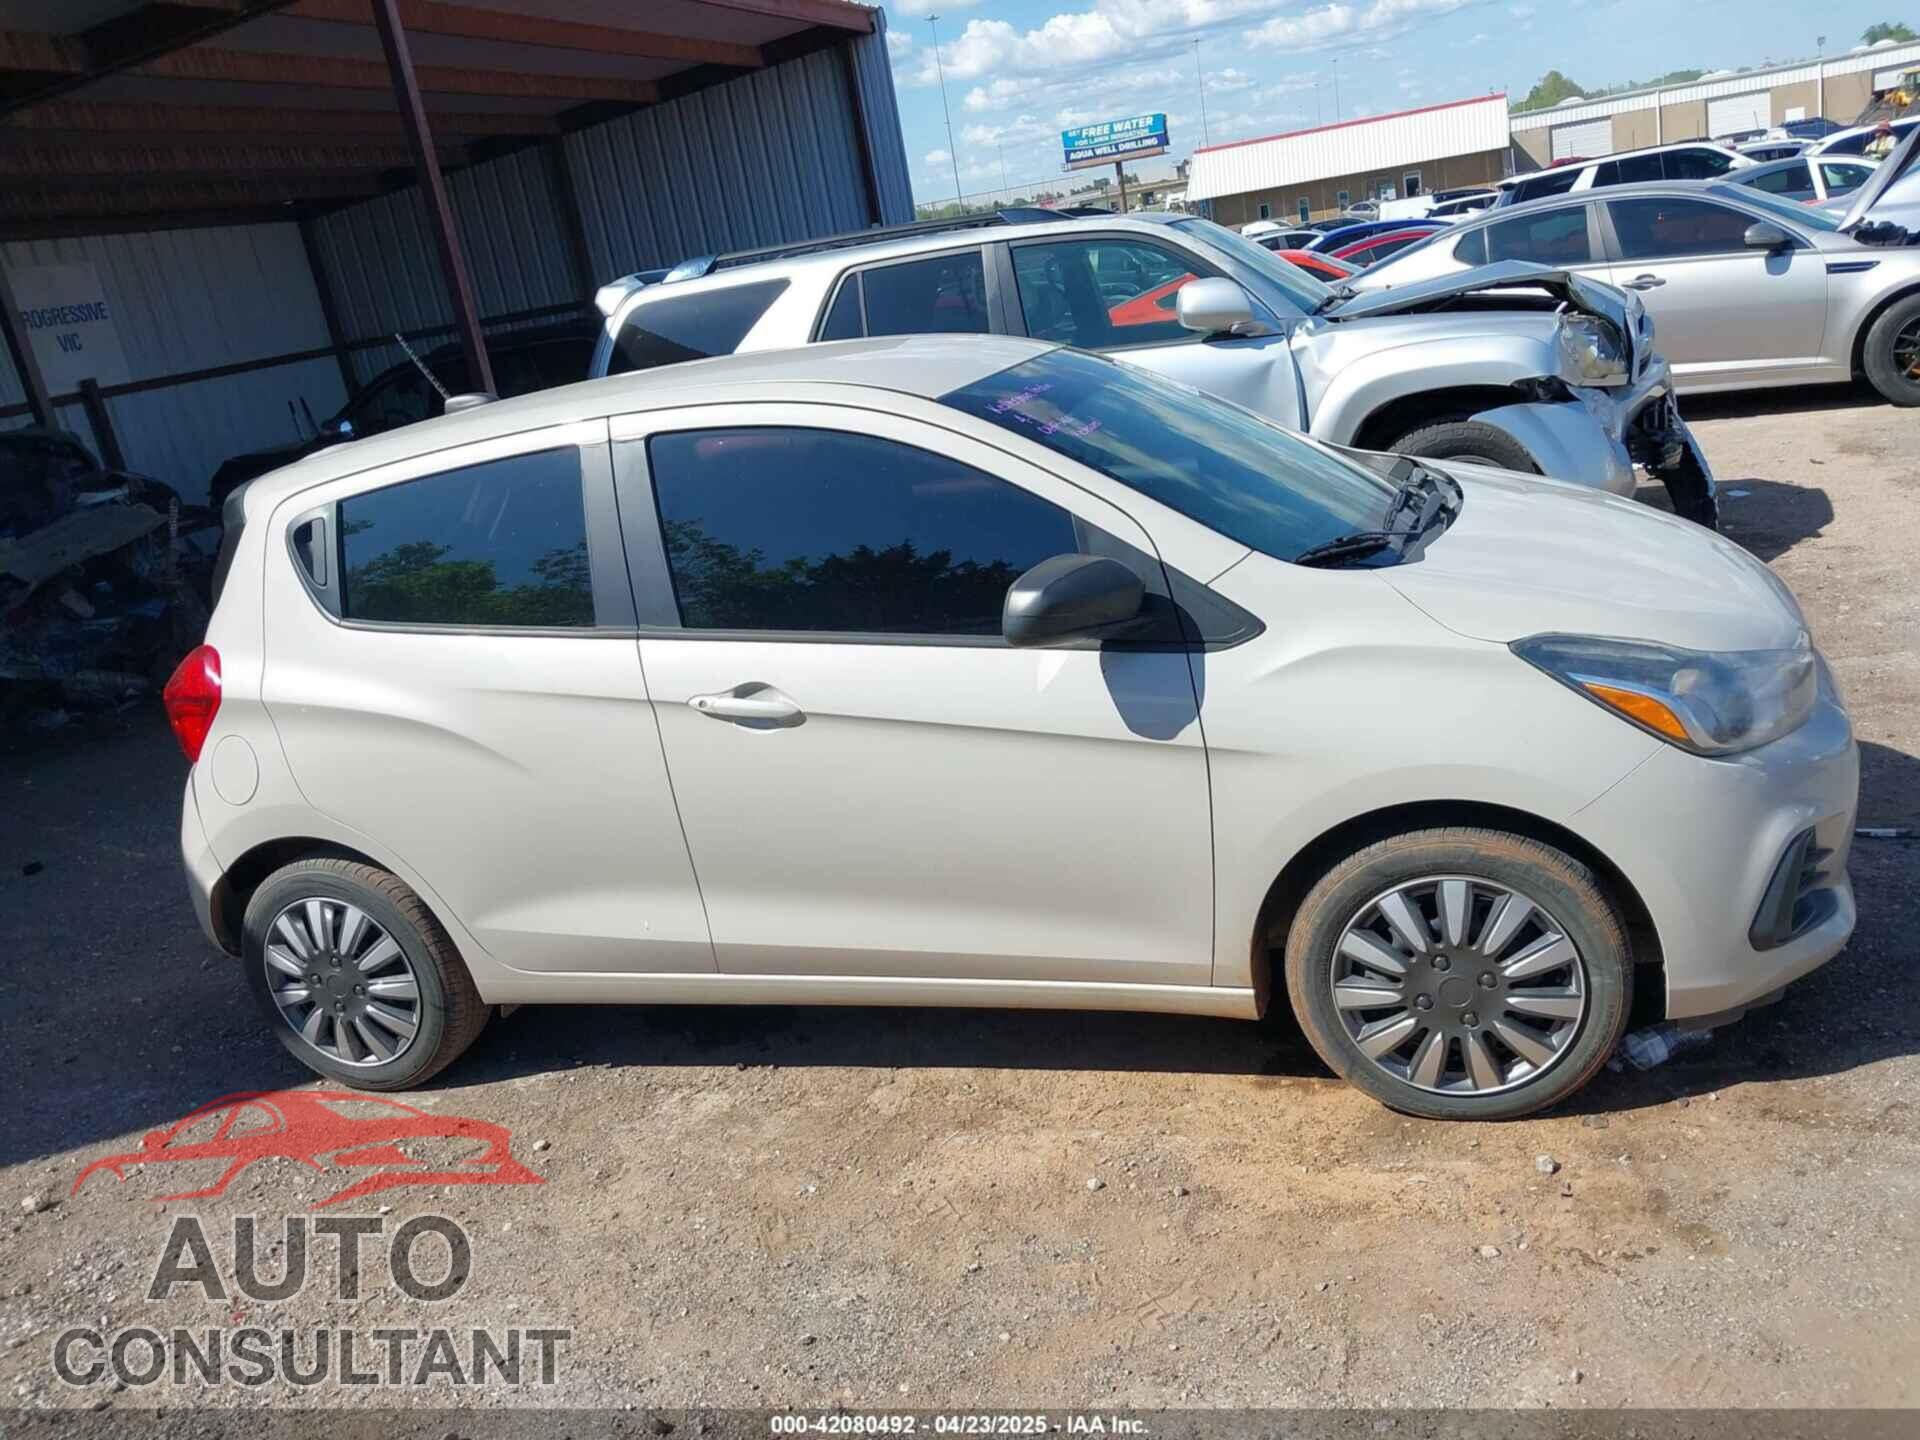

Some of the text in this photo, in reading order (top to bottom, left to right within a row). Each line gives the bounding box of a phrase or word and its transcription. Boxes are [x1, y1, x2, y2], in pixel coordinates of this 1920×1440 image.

[1082, 124, 1110, 138] FREE
[1113, 117, 1153, 131] WATER
[1070, 137, 1158, 159] AQUA WELL DRILLING
[20, 302, 109, 329] ROGRESSIVE
[56, 333, 83, 353] VIC
